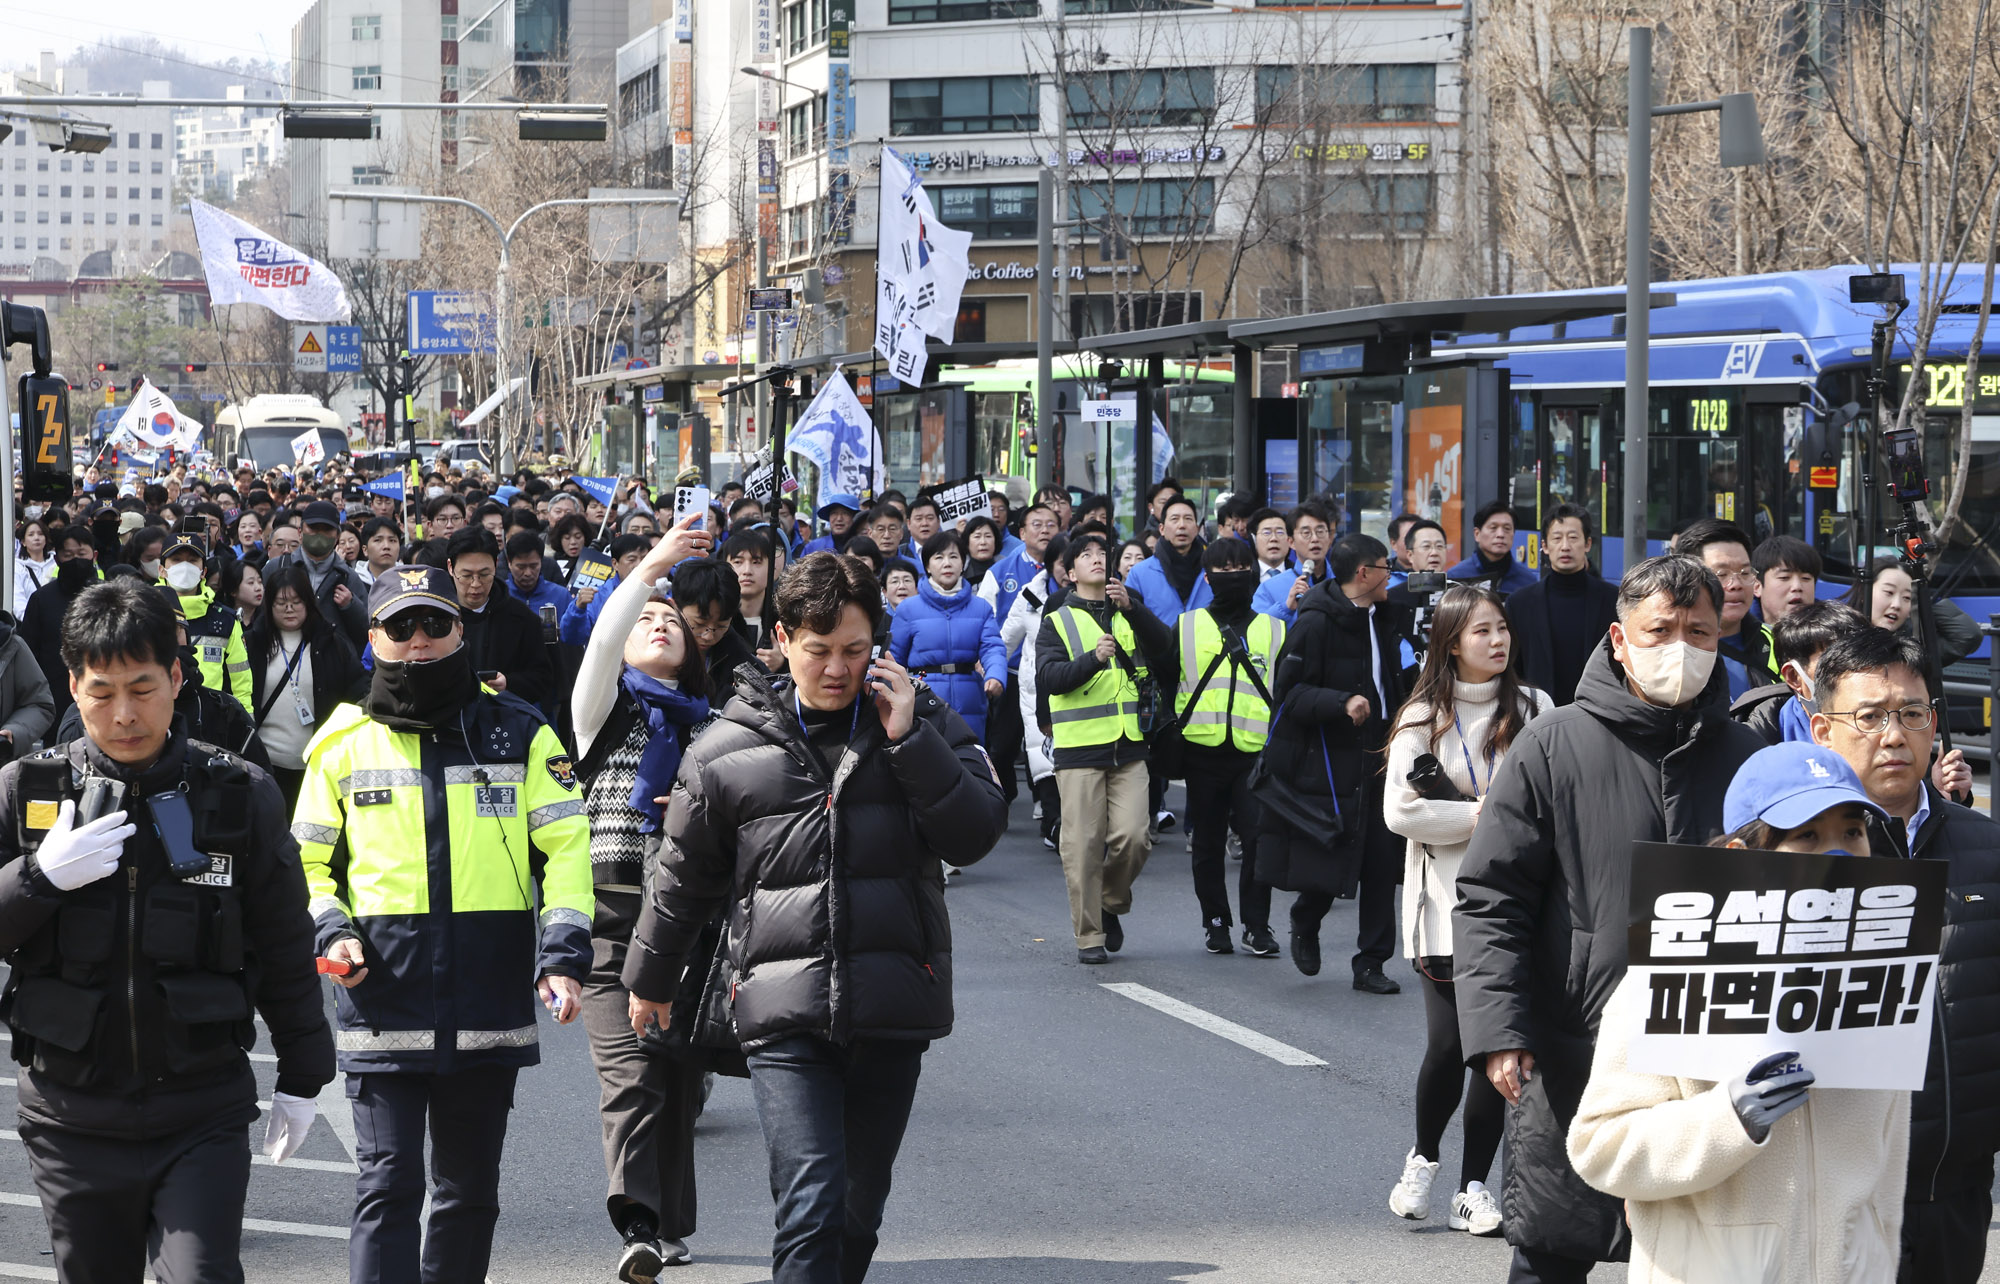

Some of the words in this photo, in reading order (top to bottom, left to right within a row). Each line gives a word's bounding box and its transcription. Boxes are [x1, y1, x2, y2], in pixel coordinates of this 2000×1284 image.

[984, 262, 1034, 280] Coffee
[421, 337, 459, 349] 중앙차로
[1978, 375, 2000, 396] 원
[1096, 407, 1122, 417] 민주당
[1691, 399, 1728, 431] 702B
[479, 788, 513, 804] 경찰
[480, 805, 514, 814] POLICE
[193, 874, 228, 885] OLICE
[1649, 884, 1917, 957] 윤석열을
[1645, 961, 1933, 1034] 파면하라!
